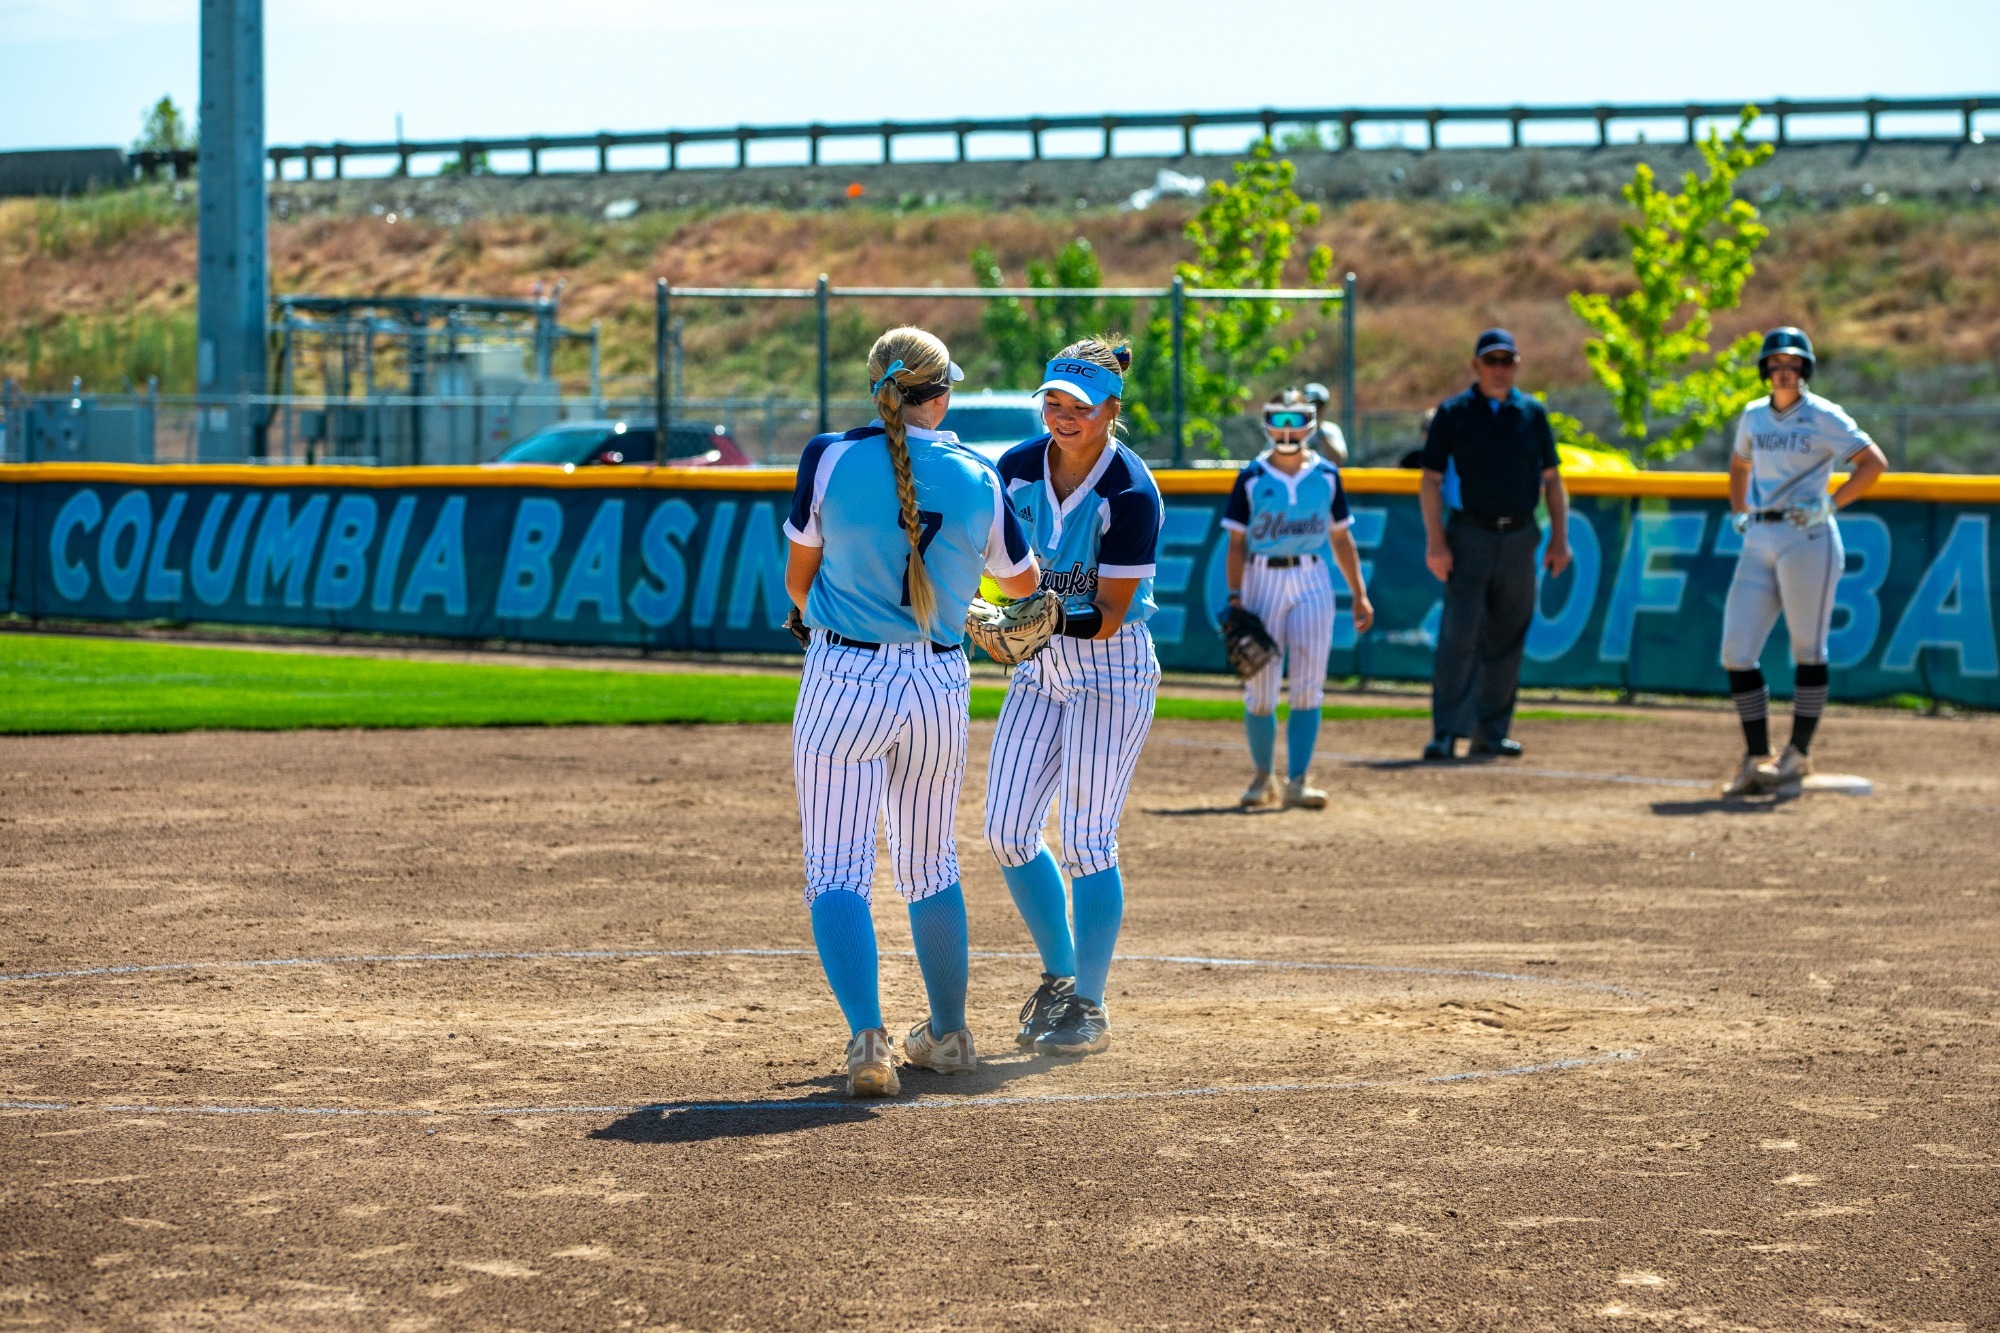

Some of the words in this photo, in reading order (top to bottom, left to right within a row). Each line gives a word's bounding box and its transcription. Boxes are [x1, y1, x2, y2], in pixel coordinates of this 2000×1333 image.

[1053, 363, 1098, 379] CBC
[50, 488, 468, 616] COLUMBIA
[494, 497, 793, 629] BASIN
[898, 508, 944, 606] 7
[1033, 555, 1099, 596] awks
[1420, 508, 1999, 678] OFBA
